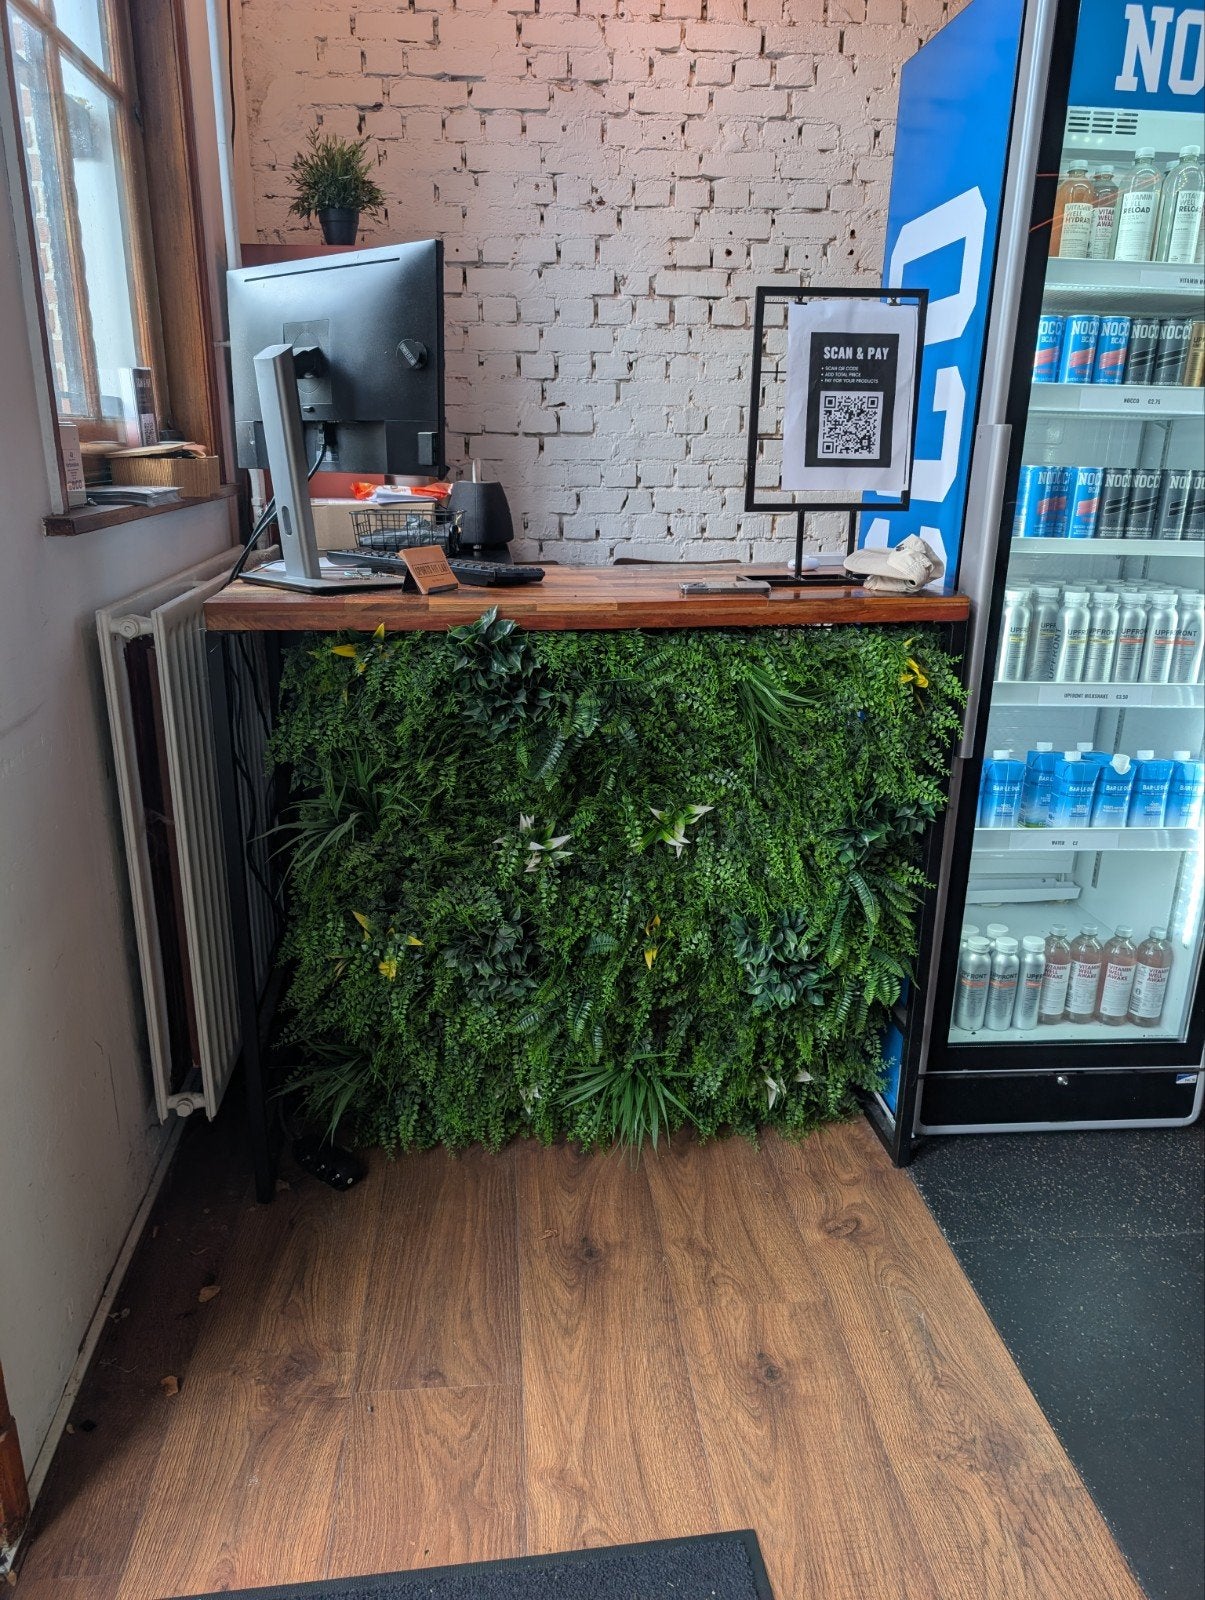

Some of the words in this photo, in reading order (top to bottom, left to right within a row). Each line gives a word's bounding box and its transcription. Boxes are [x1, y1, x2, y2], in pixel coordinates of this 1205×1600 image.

[1123, 206, 1151, 214] RELOAD
[823, 346, 853, 360] SCAN
[856, 346, 864, 360] &
[867, 346, 890, 361] PAY
